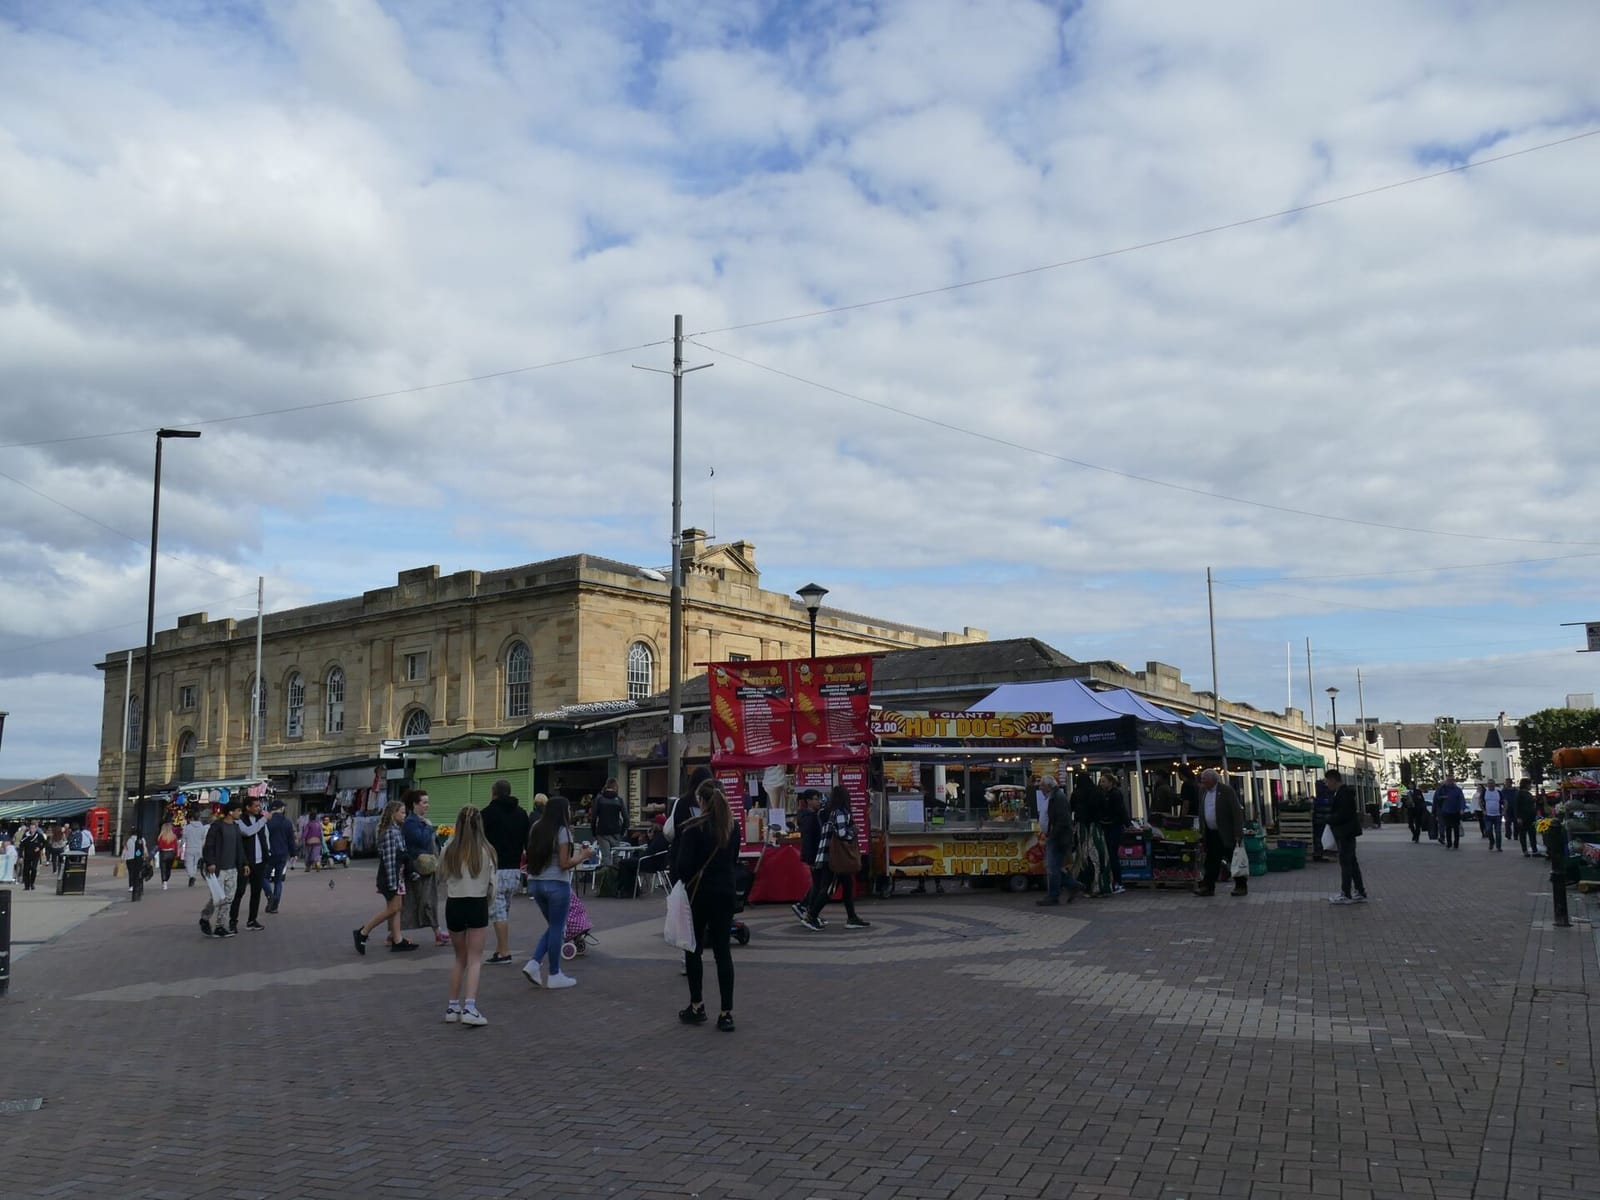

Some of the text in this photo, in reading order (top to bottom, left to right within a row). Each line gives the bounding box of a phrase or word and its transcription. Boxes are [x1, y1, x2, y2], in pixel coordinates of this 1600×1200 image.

[939, 711, 986, 719] GIANT
[905, 718, 1016, 737] HOT DOGS
[719, 776, 739, 784] MENU
[943, 842, 1019, 857] BURGERS
[931, 858, 1030, 874] & HOT DOGS
